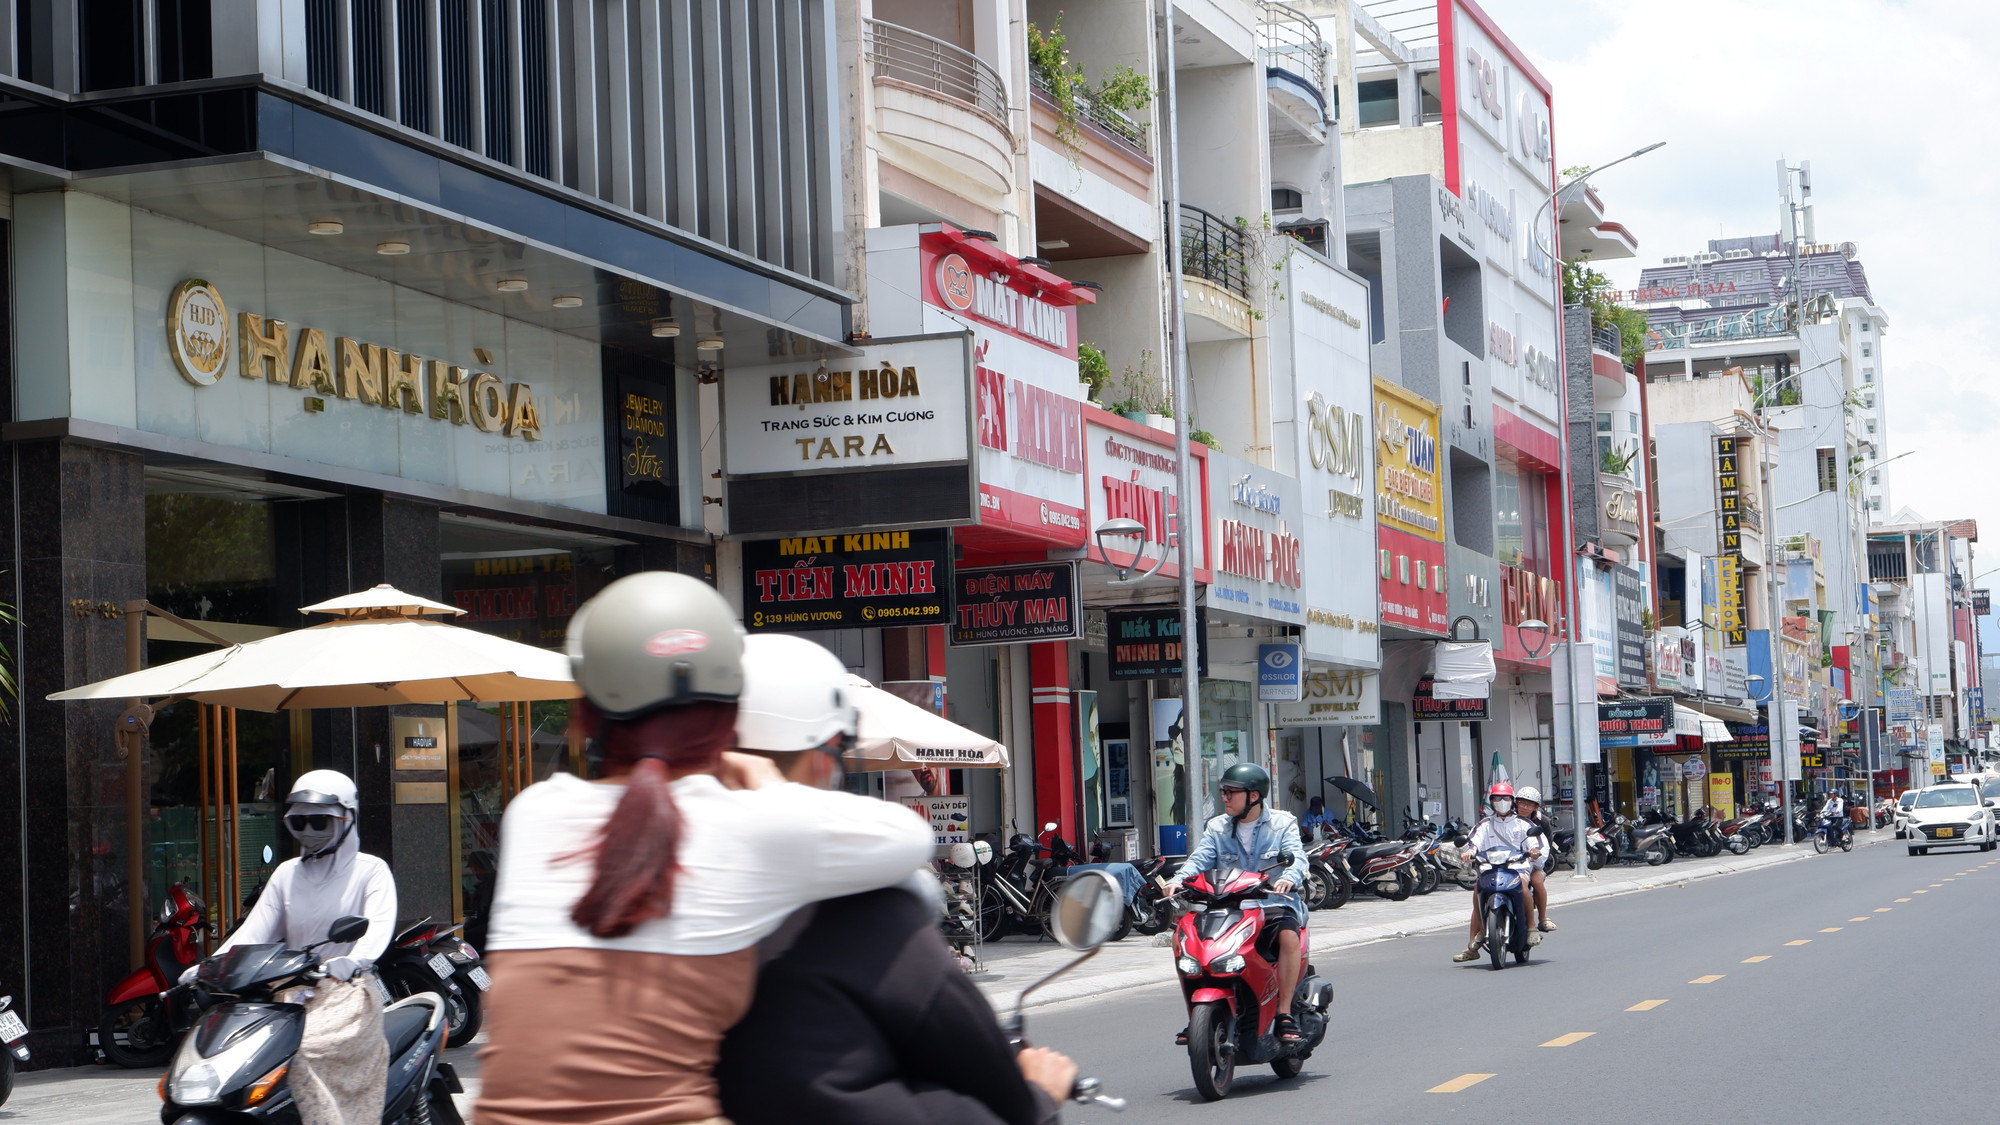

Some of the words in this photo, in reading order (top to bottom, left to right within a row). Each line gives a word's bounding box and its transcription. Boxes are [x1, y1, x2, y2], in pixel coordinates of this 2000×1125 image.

[1467, 47, 1502, 120] TCL
[1534, 112, 1549, 162] LG
[1629, 285, 1680, 302] TRUNG
[1686, 281, 1737, 297] PLAZA
[189, 302, 216, 327] HJD
[972, 272, 1018, 329] MẮT
[1018, 290, 1068, 349] KÍNH
[238, 312, 424, 413] HẠNH
[428, 348, 542, 441] HÒA
[770, 371, 852, 411] HẠNH
[859, 361, 920, 400] HÒA
[625, 393, 663, 416] JEWELRY
[627, 414, 665, 438] DIAMOND
[761, 419, 810, 431] TRANG
[813, 414, 840, 427] SỨC
[843, 415, 854, 426] &
[857, 413, 883, 425] KIM
[886, 410, 935, 423] CƯƠNG
[1008, 378, 1082, 474] MINH
[624, 436, 663, 478] Store
[795, 433, 895, 460] TARA
[1105, 435, 1123, 458] CÔNG
[755, 556, 834, 602] TIẾN
[844, 560, 936, 598] MINH
[966, 573, 1010, 596] ĐIỆN
[1015, 570, 1054, 592] MÁY
[765, 614, 783, 623] 139
[784, 611, 809, 622] HÙNG
[810, 610, 843, 621] VƯƠNG
[877, 605, 941, 618] 0905.042.999
[957, 596, 1018, 629] THÚY
[1024, 597, 1067, 624] MAI
[957, 631, 974, 640] 141
[976, 629, 998, 639] HÙNG
[1000, 627, 1028, 637] VƯƠNG
[1033, 625, 1044, 635] ĐÀ
[1121, 617, 1151, 638] Mắt
[1157, 618, 1181, 637] Kín
[1116, 643, 1159, 662] MINH
[1261, 687, 1296, 696] PARTNERS
[1309, 702, 1361, 715] JEWELRY
[1608, 707, 1633, 718] ĐỒNG
[1634, 706, 1647, 717] HỒ
[1630, 716, 1662, 730] THÀNH
[958, 748, 984, 758] HÒA
[931, 801, 950, 810] GIÀY
[952, 800, 967, 809] DÉP
[950, 835, 963, 843] XI
